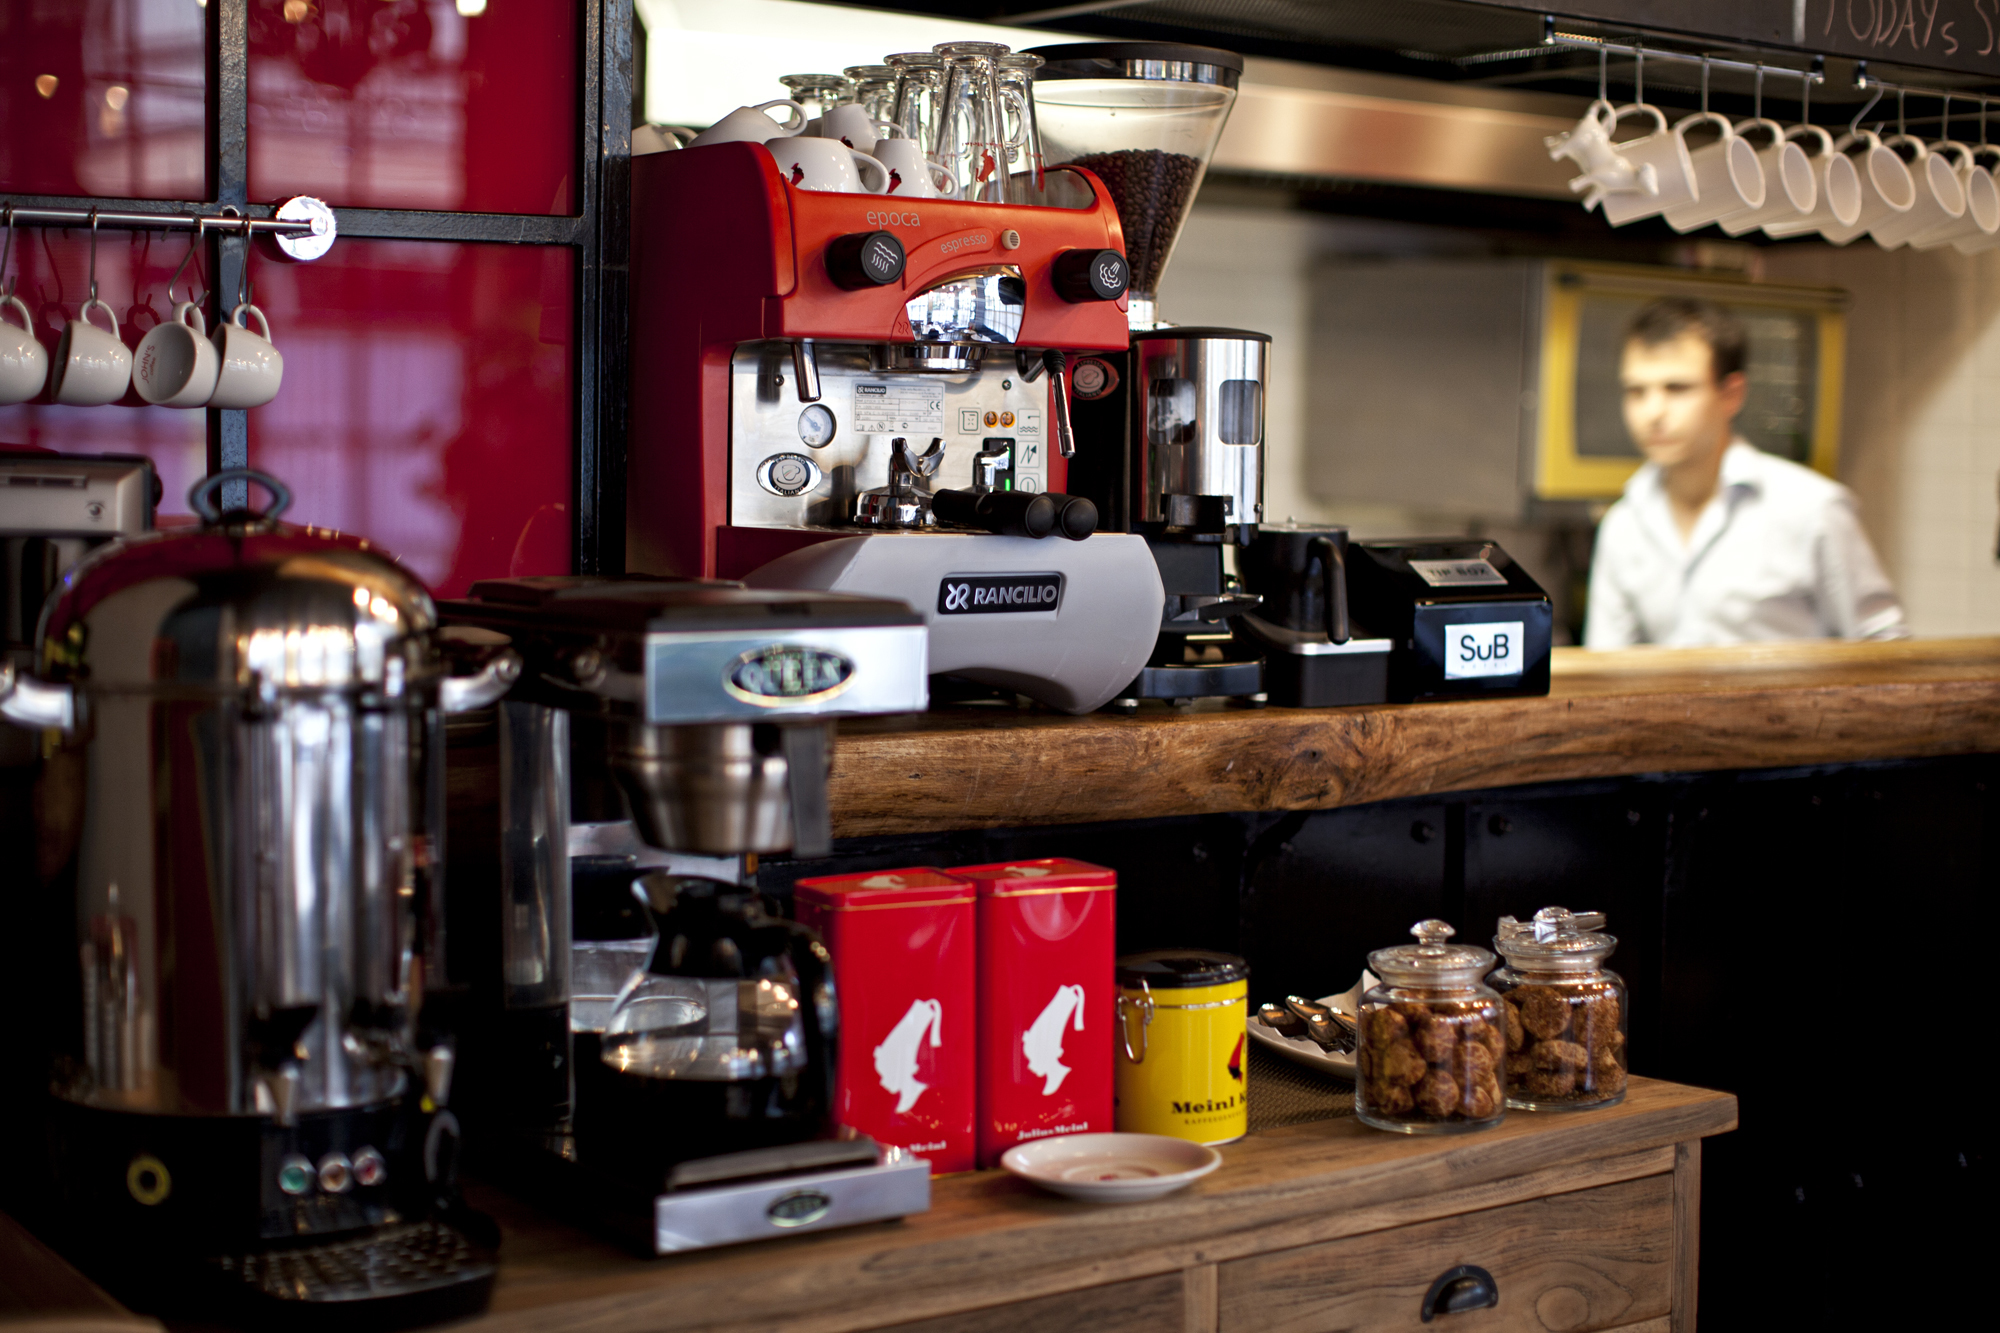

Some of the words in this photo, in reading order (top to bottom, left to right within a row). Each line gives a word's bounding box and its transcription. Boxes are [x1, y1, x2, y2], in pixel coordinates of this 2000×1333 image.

[866, 210, 921, 231] epoca
[940, 234, 988, 254] espresso
[141, 345, 155, 383] JOHN'S
[974, 584, 1057, 605] RANCILIO
[1460, 633, 1510, 662] SuB
[1171, 1095, 1235, 1115] Meinl
